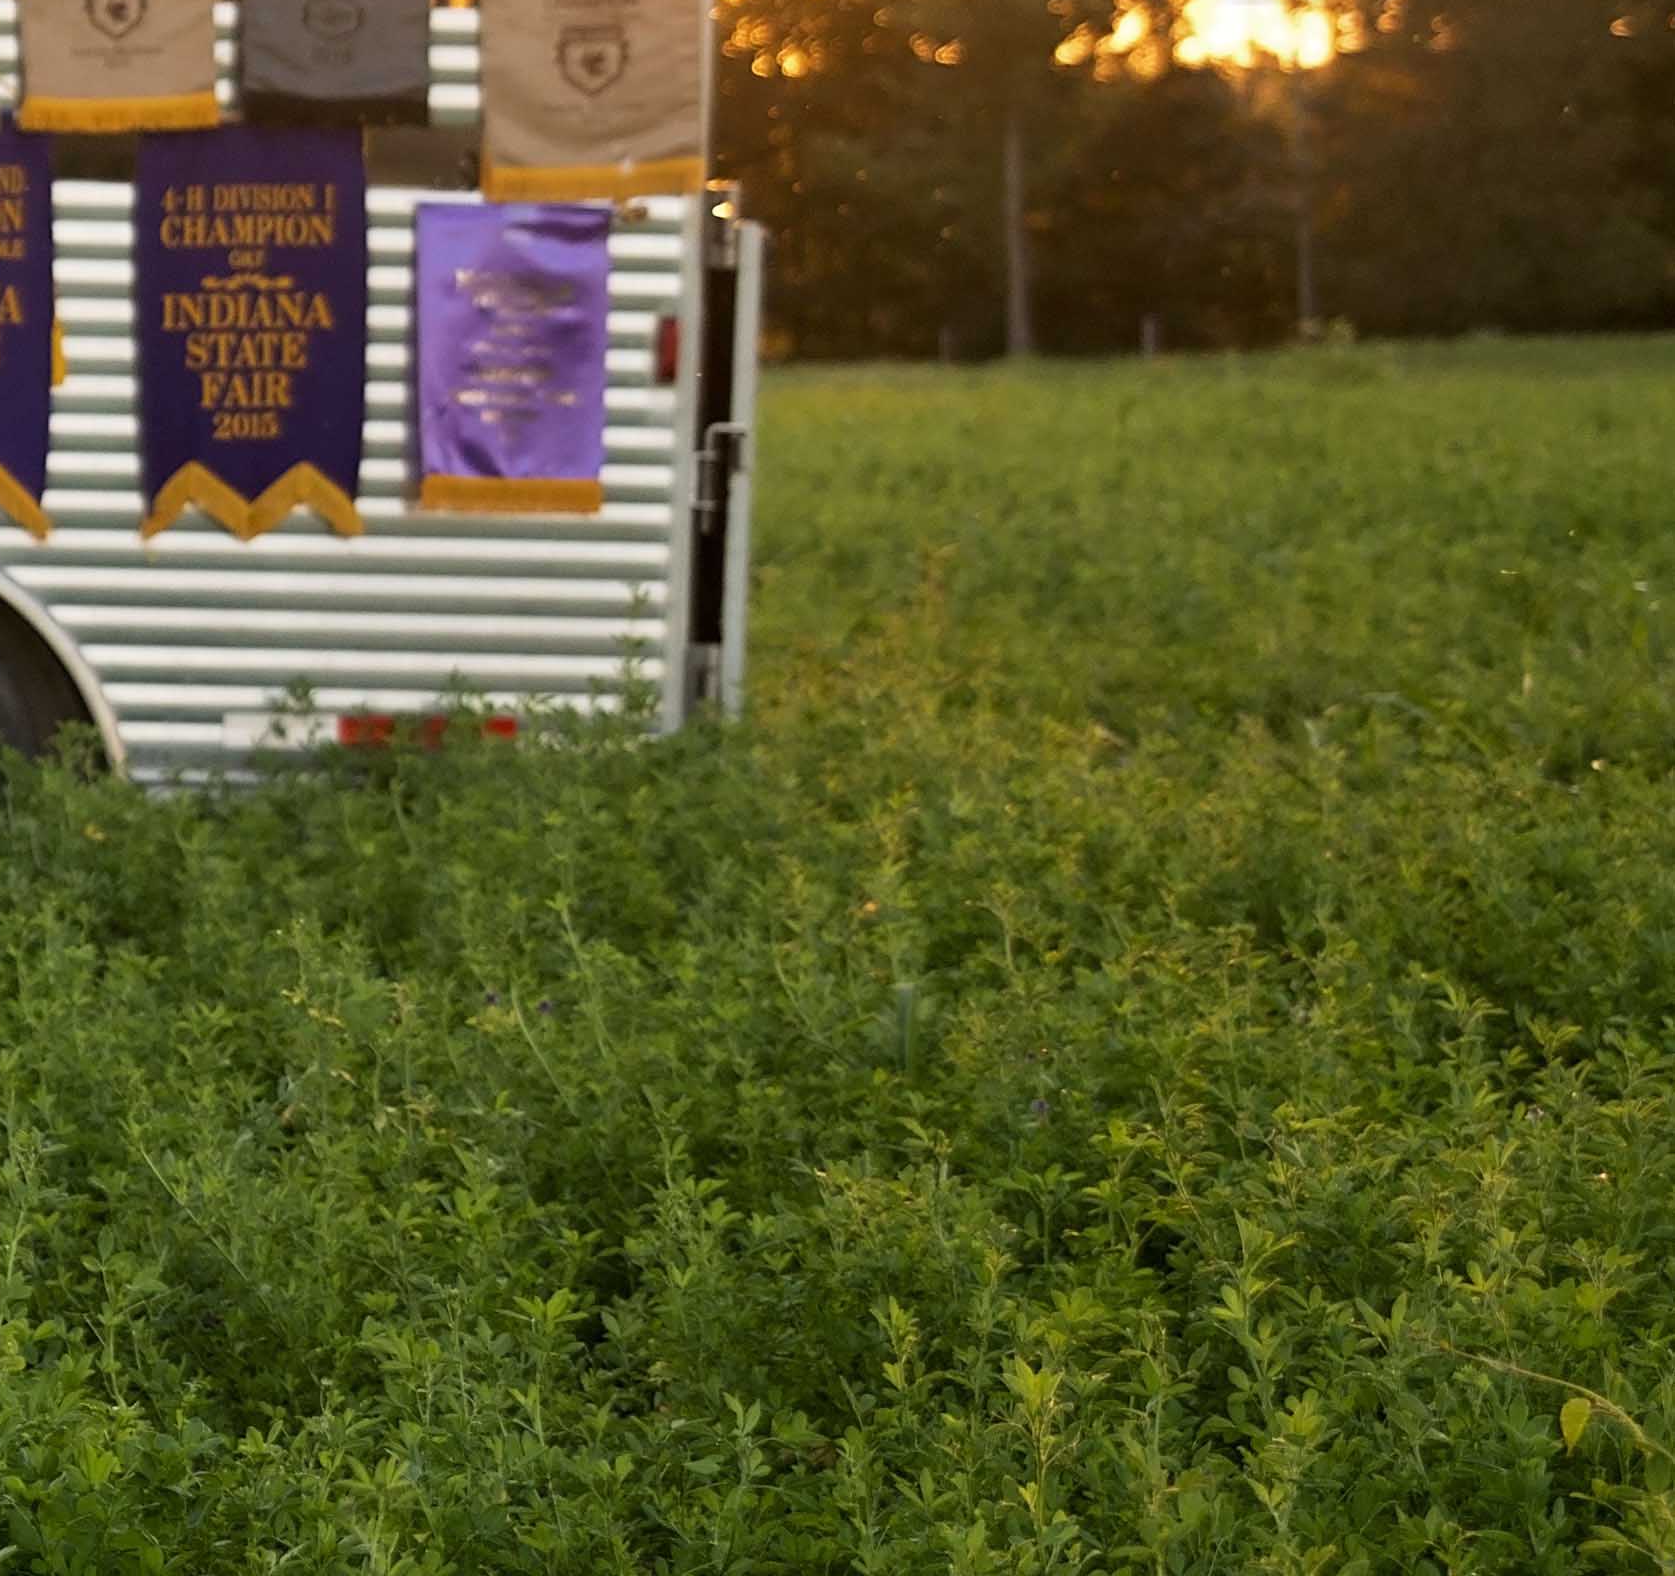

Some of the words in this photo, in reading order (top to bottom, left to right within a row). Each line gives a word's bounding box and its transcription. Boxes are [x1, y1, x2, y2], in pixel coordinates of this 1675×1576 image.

[213, 183, 315, 212] DIVISION
[160, 214, 336, 248] CHAMPION
[161, 293, 334, 331] INDIANA
[185, 332, 307, 370] STATE
[200, 371, 293, 409] FAIR
[212, 412, 281, 441] 2015
